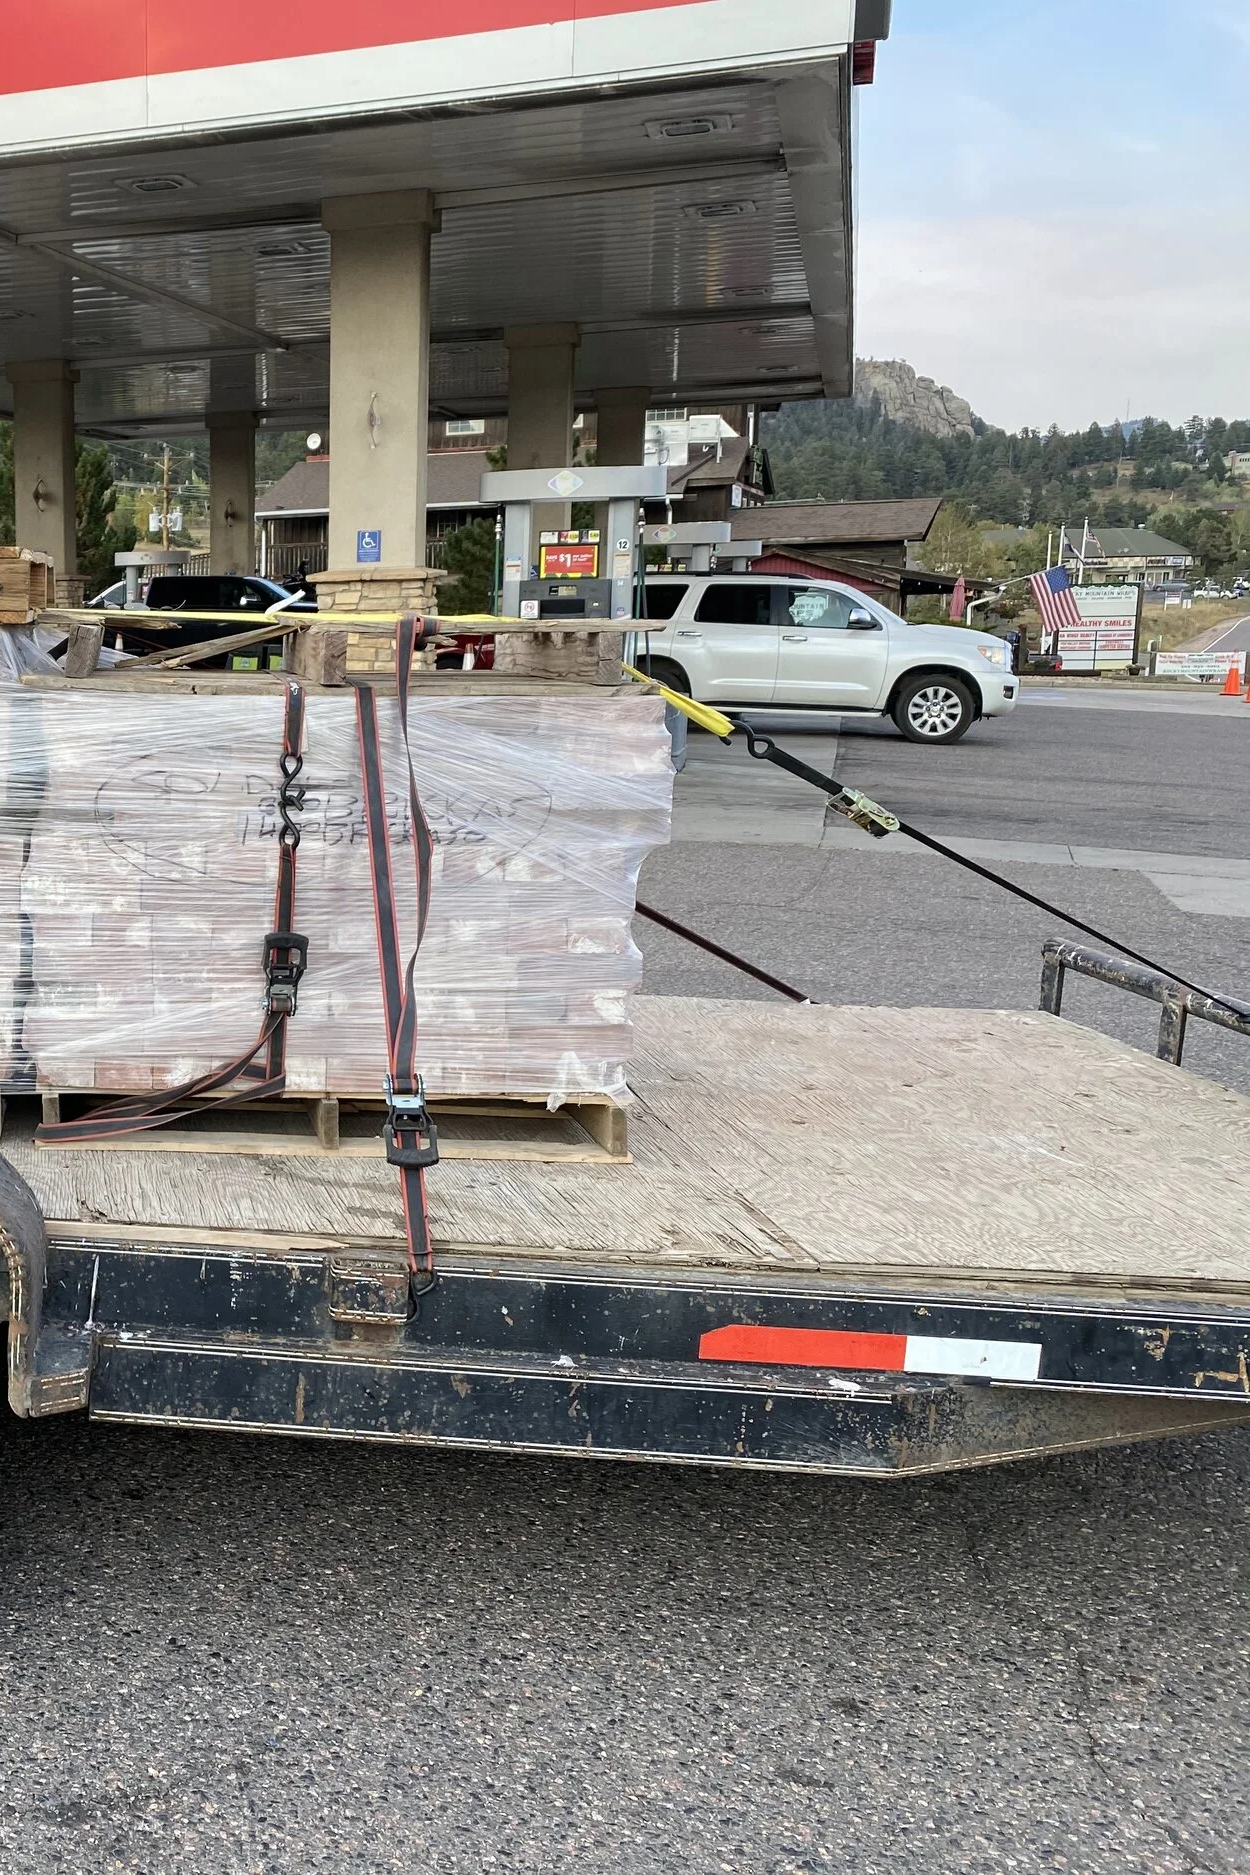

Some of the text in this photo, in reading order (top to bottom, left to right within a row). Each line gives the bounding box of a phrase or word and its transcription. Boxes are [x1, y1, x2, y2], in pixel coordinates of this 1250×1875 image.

[618, 541, 628, 549] 12
[559, 553, 571, 568] $1
[1104, 619, 1132, 627] SMILES
